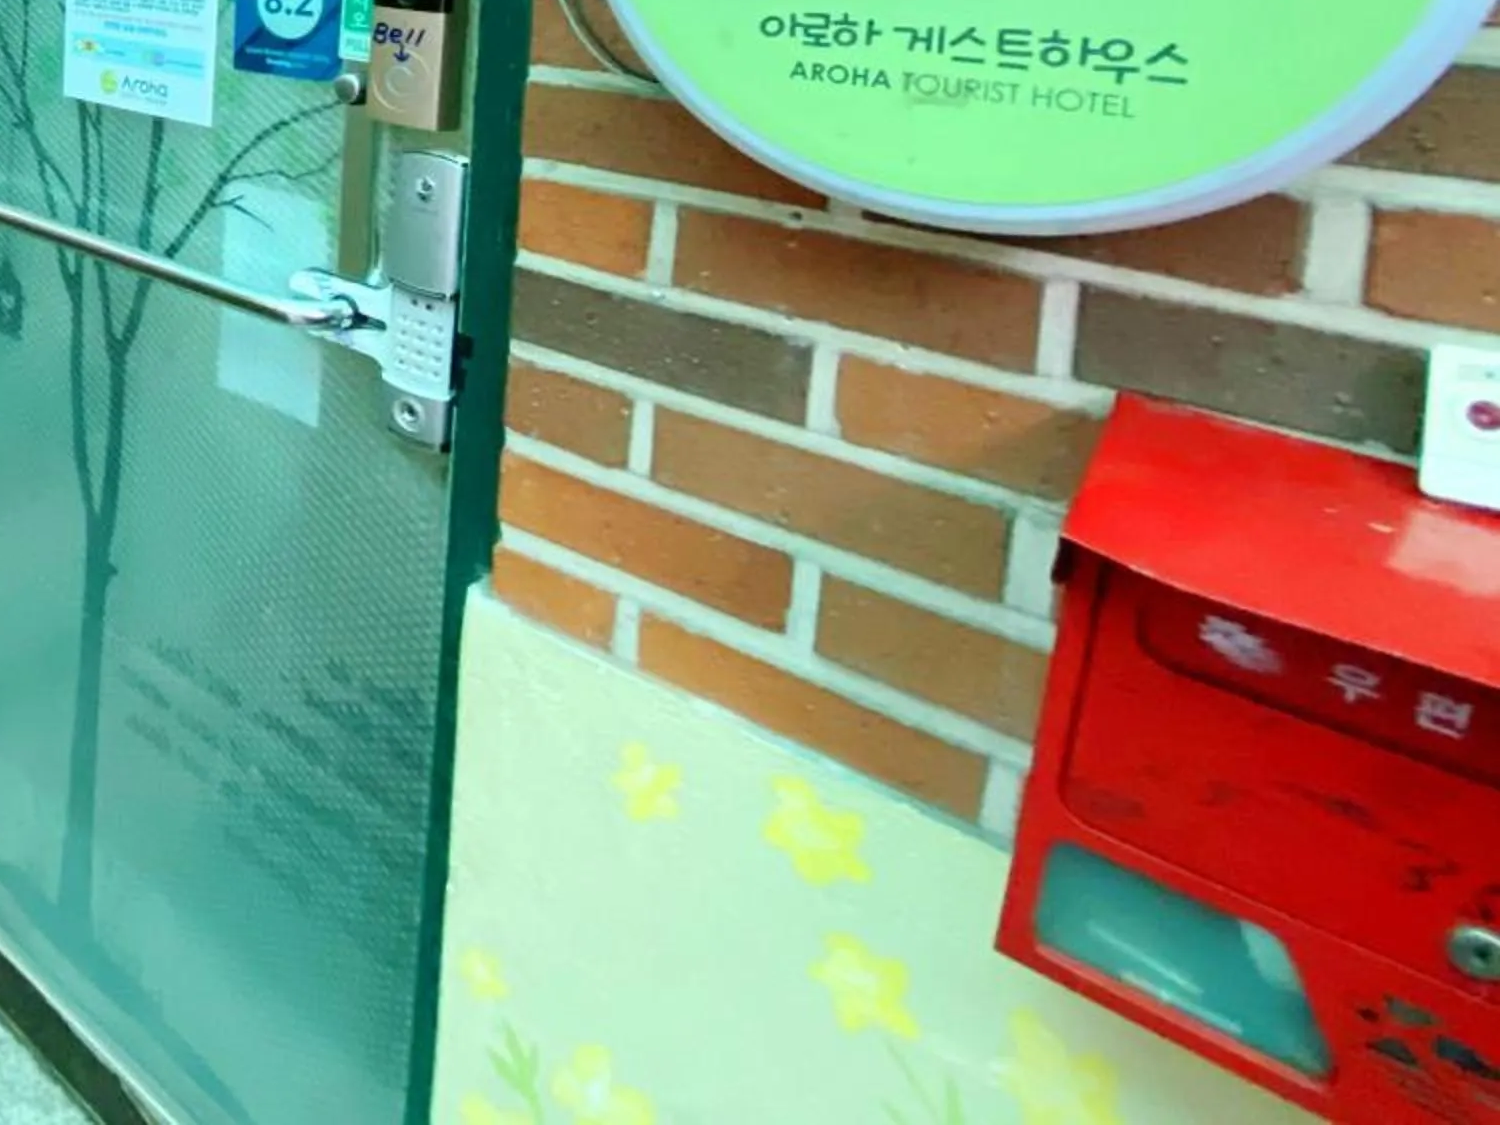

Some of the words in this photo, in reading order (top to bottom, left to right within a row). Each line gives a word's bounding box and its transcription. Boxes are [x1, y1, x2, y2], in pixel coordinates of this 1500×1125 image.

[759, 12, 883, 49] 아로하
[893, 25, 1189, 86] 게스트하우스
[788, 61, 892, 90] AROHA
[901, 72, 1021, 105] TOURIST
[1031, 85, 1137, 119] HOTEL
